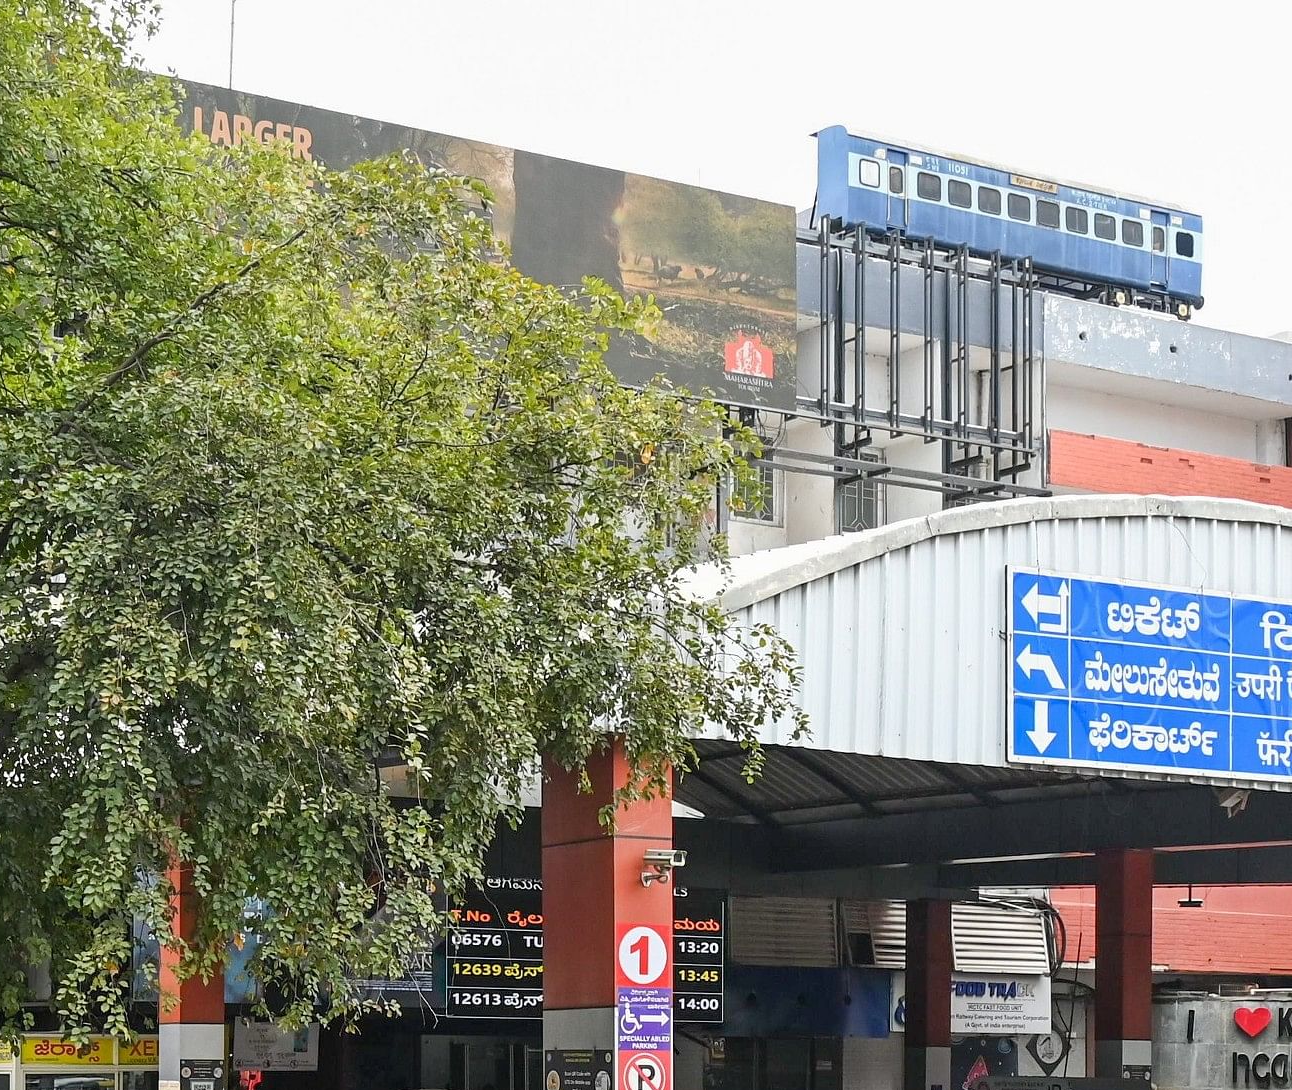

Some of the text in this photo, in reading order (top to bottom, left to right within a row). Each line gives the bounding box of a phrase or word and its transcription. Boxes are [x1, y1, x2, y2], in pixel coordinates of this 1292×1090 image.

[194, 107, 312, 161] LARGER
[1108, 596, 1200, 639] ಟಿಕೆಟ್
[1236, 665, 1283, 700] उपरी
[451, 909, 490, 922] T.No
[673, 919, 719, 932] ಮಯ
[451, 935, 502, 947] 06576
[679, 941, 719, 954] 13:20
[630, 936, 649, 975] 1
[453, 963, 502, 976] 12639
[679, 970, 718, 982] 13:45
[951, 981, 987, 997] FOOD
[453, 993, 501, 1005] 12613
[679, 999, 719, 1010] 14:00
[1187, 1009, 1195, 1043] I
